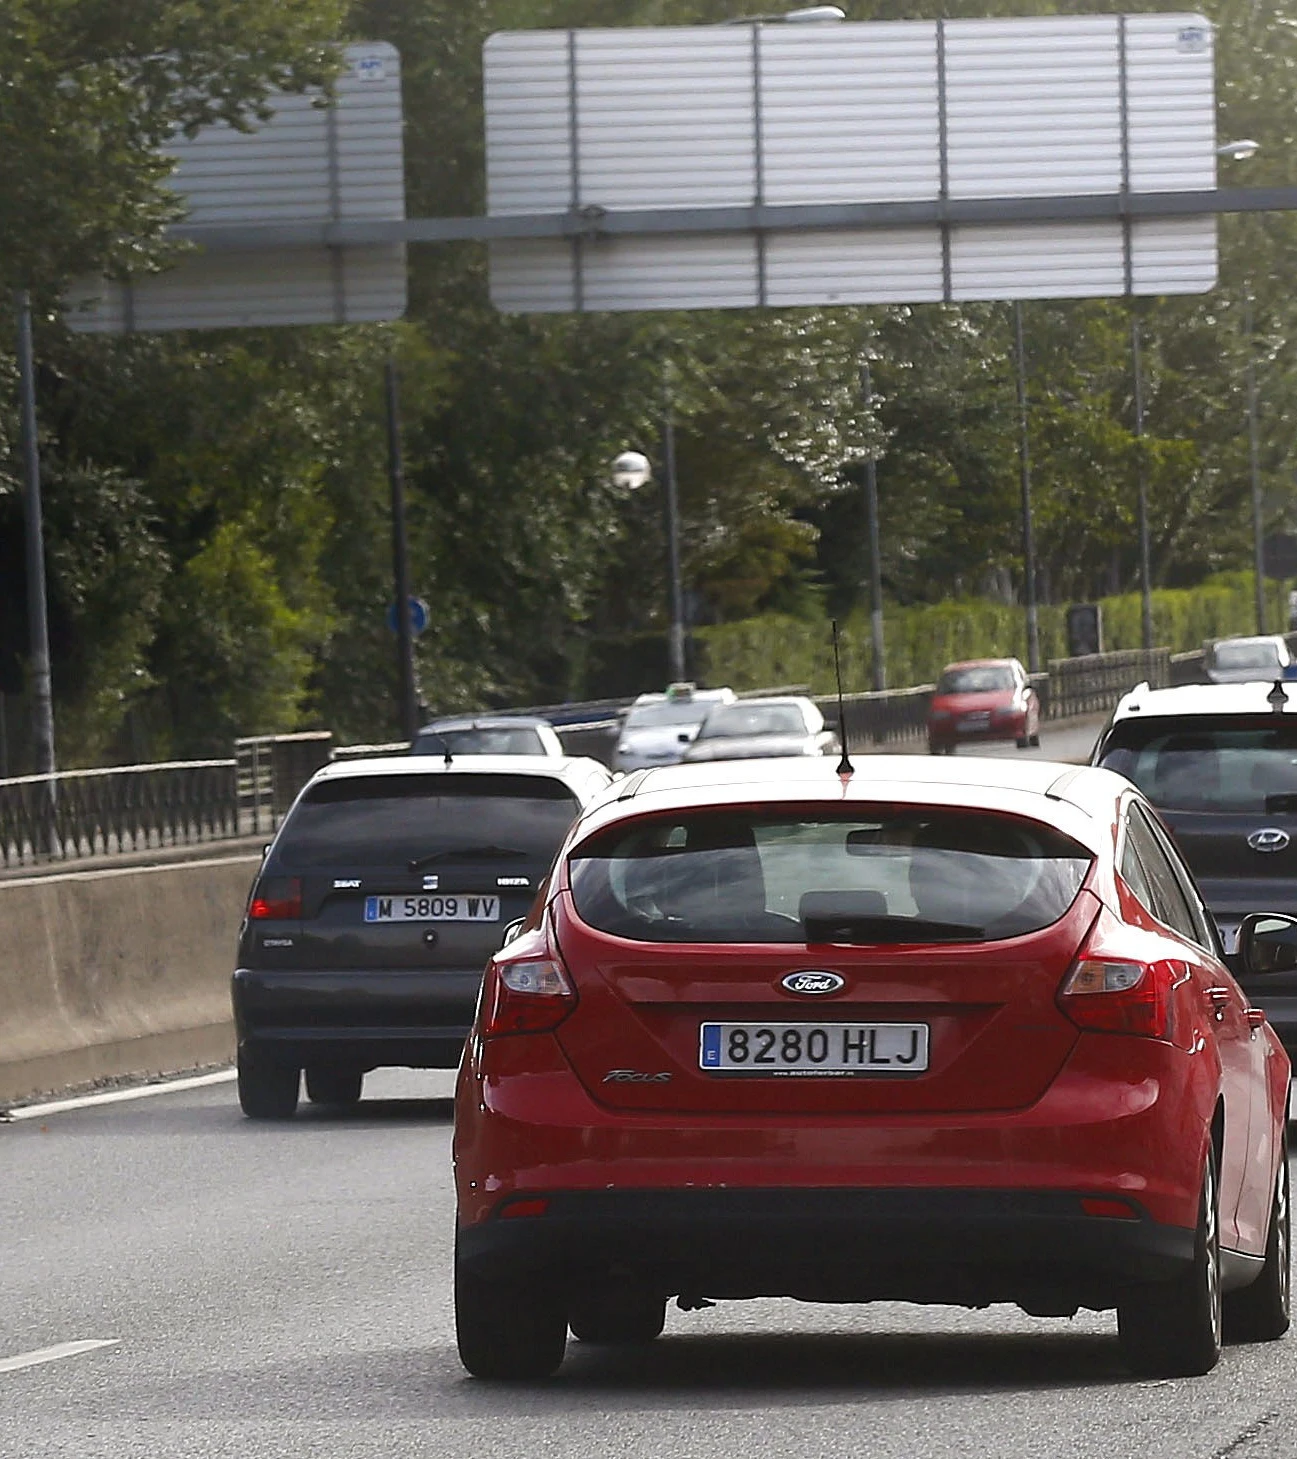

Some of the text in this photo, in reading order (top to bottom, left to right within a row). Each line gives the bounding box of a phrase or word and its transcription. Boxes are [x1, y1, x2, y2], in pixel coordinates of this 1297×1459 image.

[333, 879, 361, 888] SEAT
[497, 877, 530, 886] IBIZA
[379, 898, 495, 917] M 5809 WV
[795, 974, 831, 990] Ford
[707, 1029, 919, 1064] E 8280 HLJ
